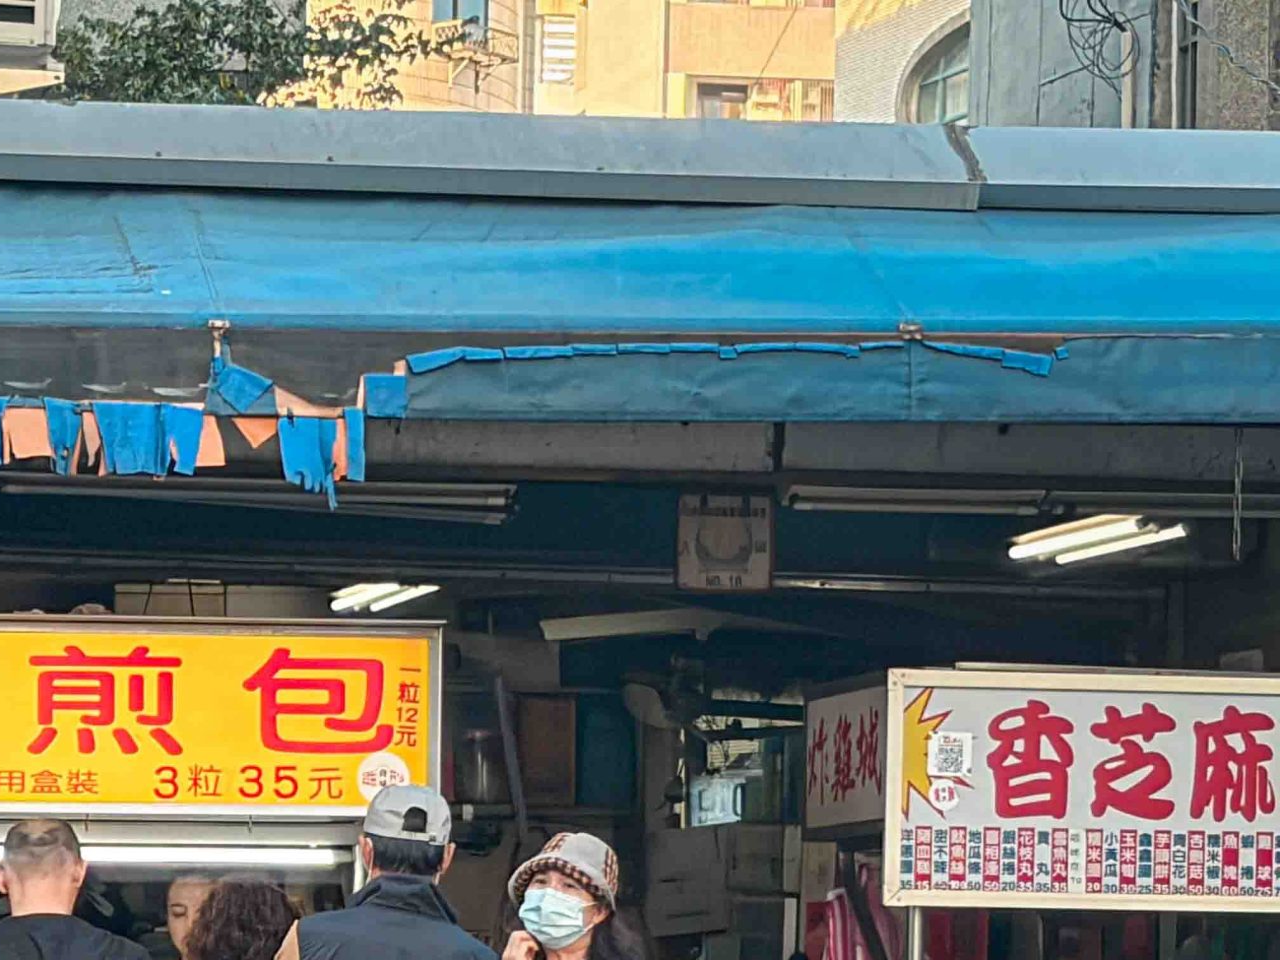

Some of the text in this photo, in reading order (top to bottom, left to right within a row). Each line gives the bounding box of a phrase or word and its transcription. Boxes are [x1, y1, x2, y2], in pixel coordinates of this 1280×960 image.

[394, 666, 421, 748] 一粒12元
[986, 700, 1275, 822] 香芝麻
